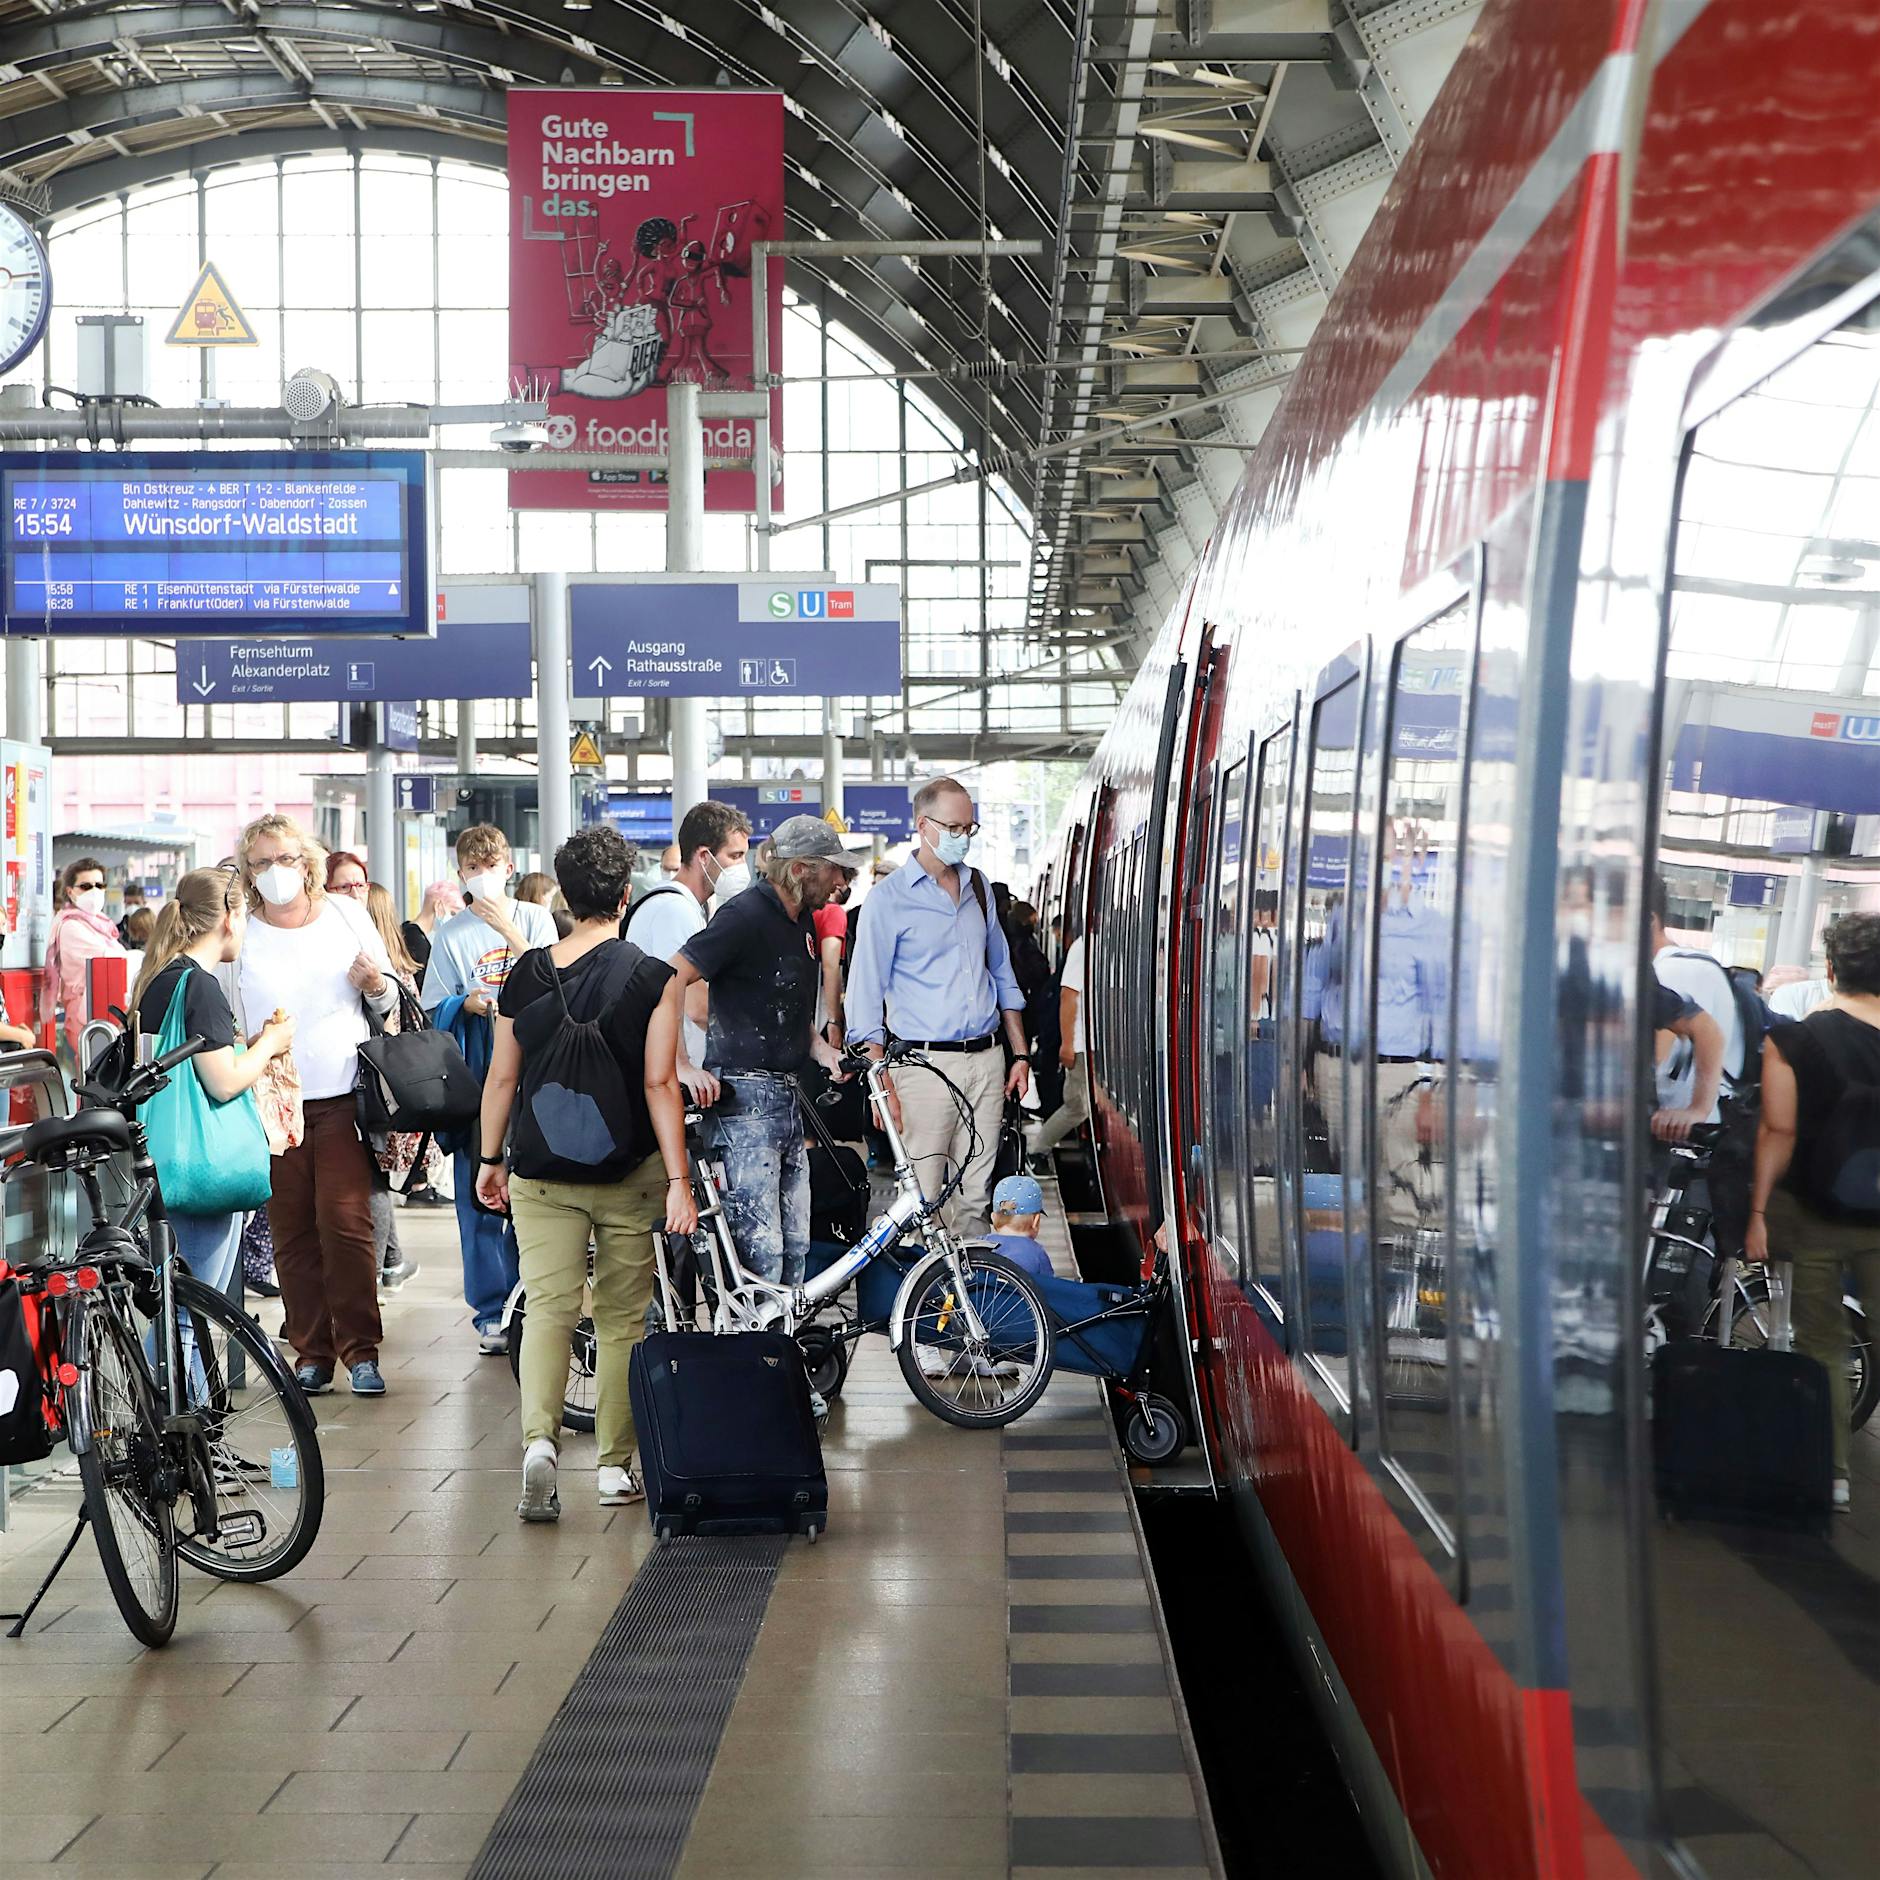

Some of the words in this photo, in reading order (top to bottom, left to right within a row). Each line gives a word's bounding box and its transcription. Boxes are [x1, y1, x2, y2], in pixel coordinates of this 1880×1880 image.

[541, 115, 608, 139] Gute
[542, 141, 674, 165] Nachbarn
[542, 166, 650, 198] bringen
[542, 193, 598, 217] das.
[586, 418, 752, 456] foodpnda
[123, 483, 140, 495] Bln
[144, 483, 194, 495] Ostkreuz
[220, 483, 239, 495] BER
[243, 483, 251, 495] T
[255, 483, 273, 495] 1-2
[285, 483, 356, 495] Blankenfelde
[13, 498, 27, 509] RE
[31, 498, 37, 509] 7
[41, 498, 47, 509] /
[51, 498, 76, 509] 3724
[123, 498, 179, 509] Dahlewitz
[192, 498, 246, 511] Rangsdorf
[260, 498, 315, 509] Dabendorf
[328, 498, 367, 509] Zossen
[14, 513, 72, 535] 15:54
[123, 513, 358, 535] Wünsdorf-Waldstadt
[46, 584, 73, 595] 15:58
[125, 584, 137, 595] RE
[142, 584, 148, 595] 1
[157, 584, 254, 595] Eisenhüttenstadt
[264, 585, 279, 594] via
[284, 584, 360, 595] Fürstenwalde
[46, 599, 73, 609] 16:28
[125, 599, 137, 609] RE
[142, 599, 148, 609] 1
[157, 599, 244, 609] Frankfurt(Oder)
[254, 599, 269, 608] via
[273, 598, 350, 609] Fürstenwalde
[771, 593, 791, 617] S
[802, 593, 820, 617] U
[829, 600, 852, 609] Tram
[230, 645, 313, 659] Fernsehturm
[627, 640, 685, 656] Ausgang
[231, 664, 330, 679] Alexanderplatz
[627, 659, 722, 672] Rathausstraße
[232, 684, 245, 693] Exit
[251, 684, 273, 693] Sortie
[627, 679, 641, 688] Exit
[647, 679, 670, 688] Sortie
